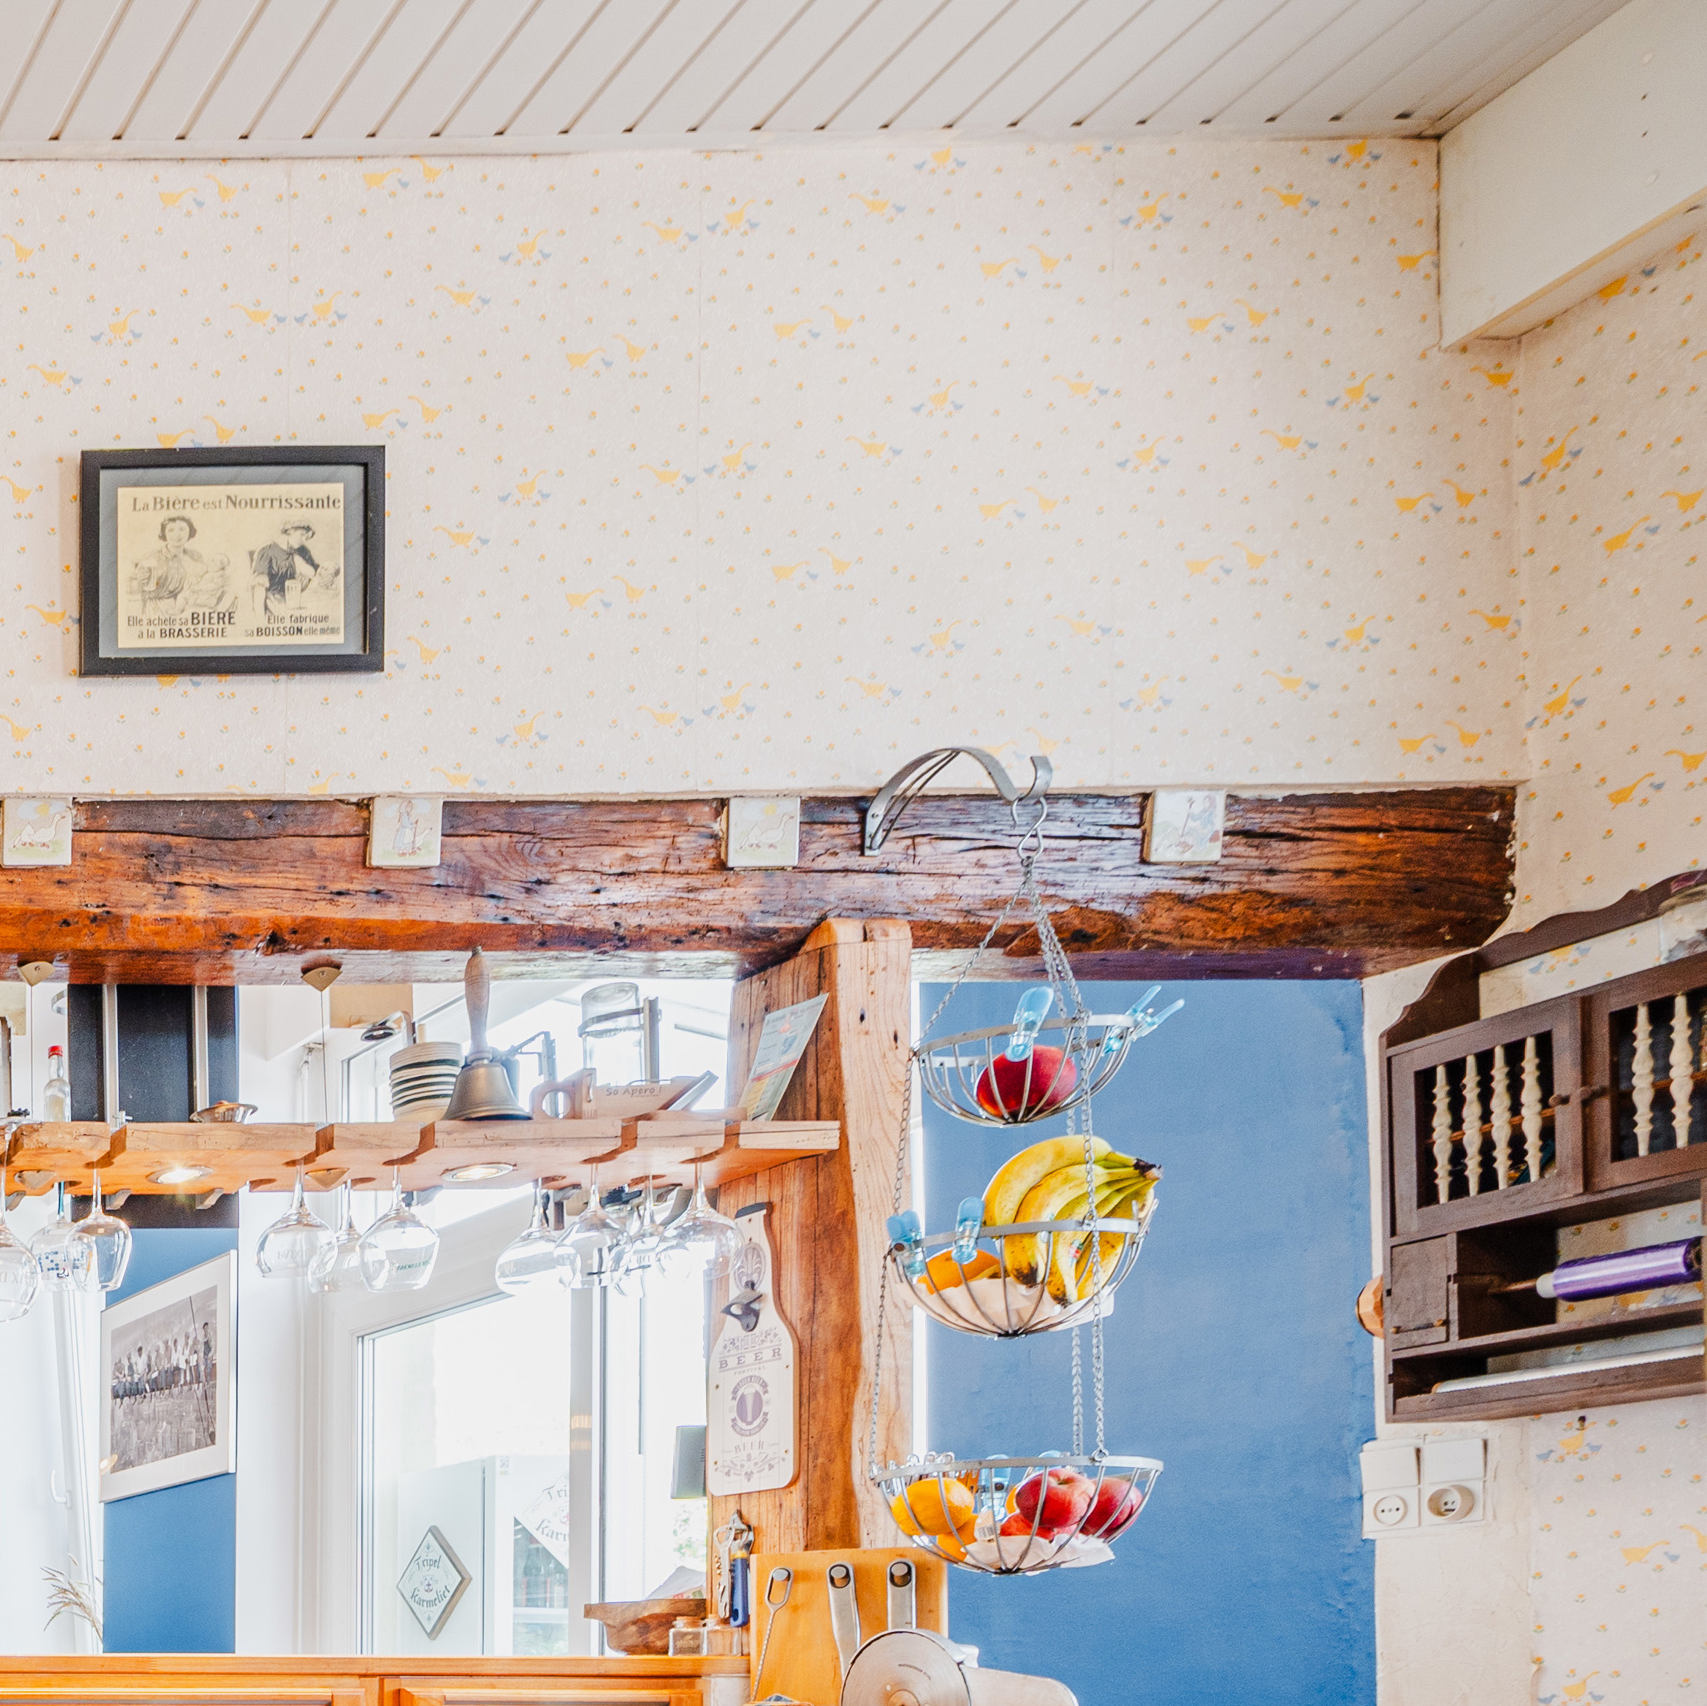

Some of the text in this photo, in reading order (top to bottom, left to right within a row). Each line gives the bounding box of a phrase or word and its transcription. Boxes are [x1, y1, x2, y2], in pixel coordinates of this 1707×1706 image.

[132, 494, 341, 512] La Bière est Nourrissante
[127, 615, 144, 627] Elle
[178, 617, 189, 626] sa
[267, 613, 330, 626] Elle fabrique
[147, 627, 156, 639] la
[159, 626, 228, 639] BRASSERIE
[256, 626, 303, 638] BOISSON
[718, 1347, 783, 1370] BEER
[734, 1440, 766, 1454] BEER
[414, 1554, 442, 1572] Tripel
[410, 1585, 451, 1609] Karmeliet
